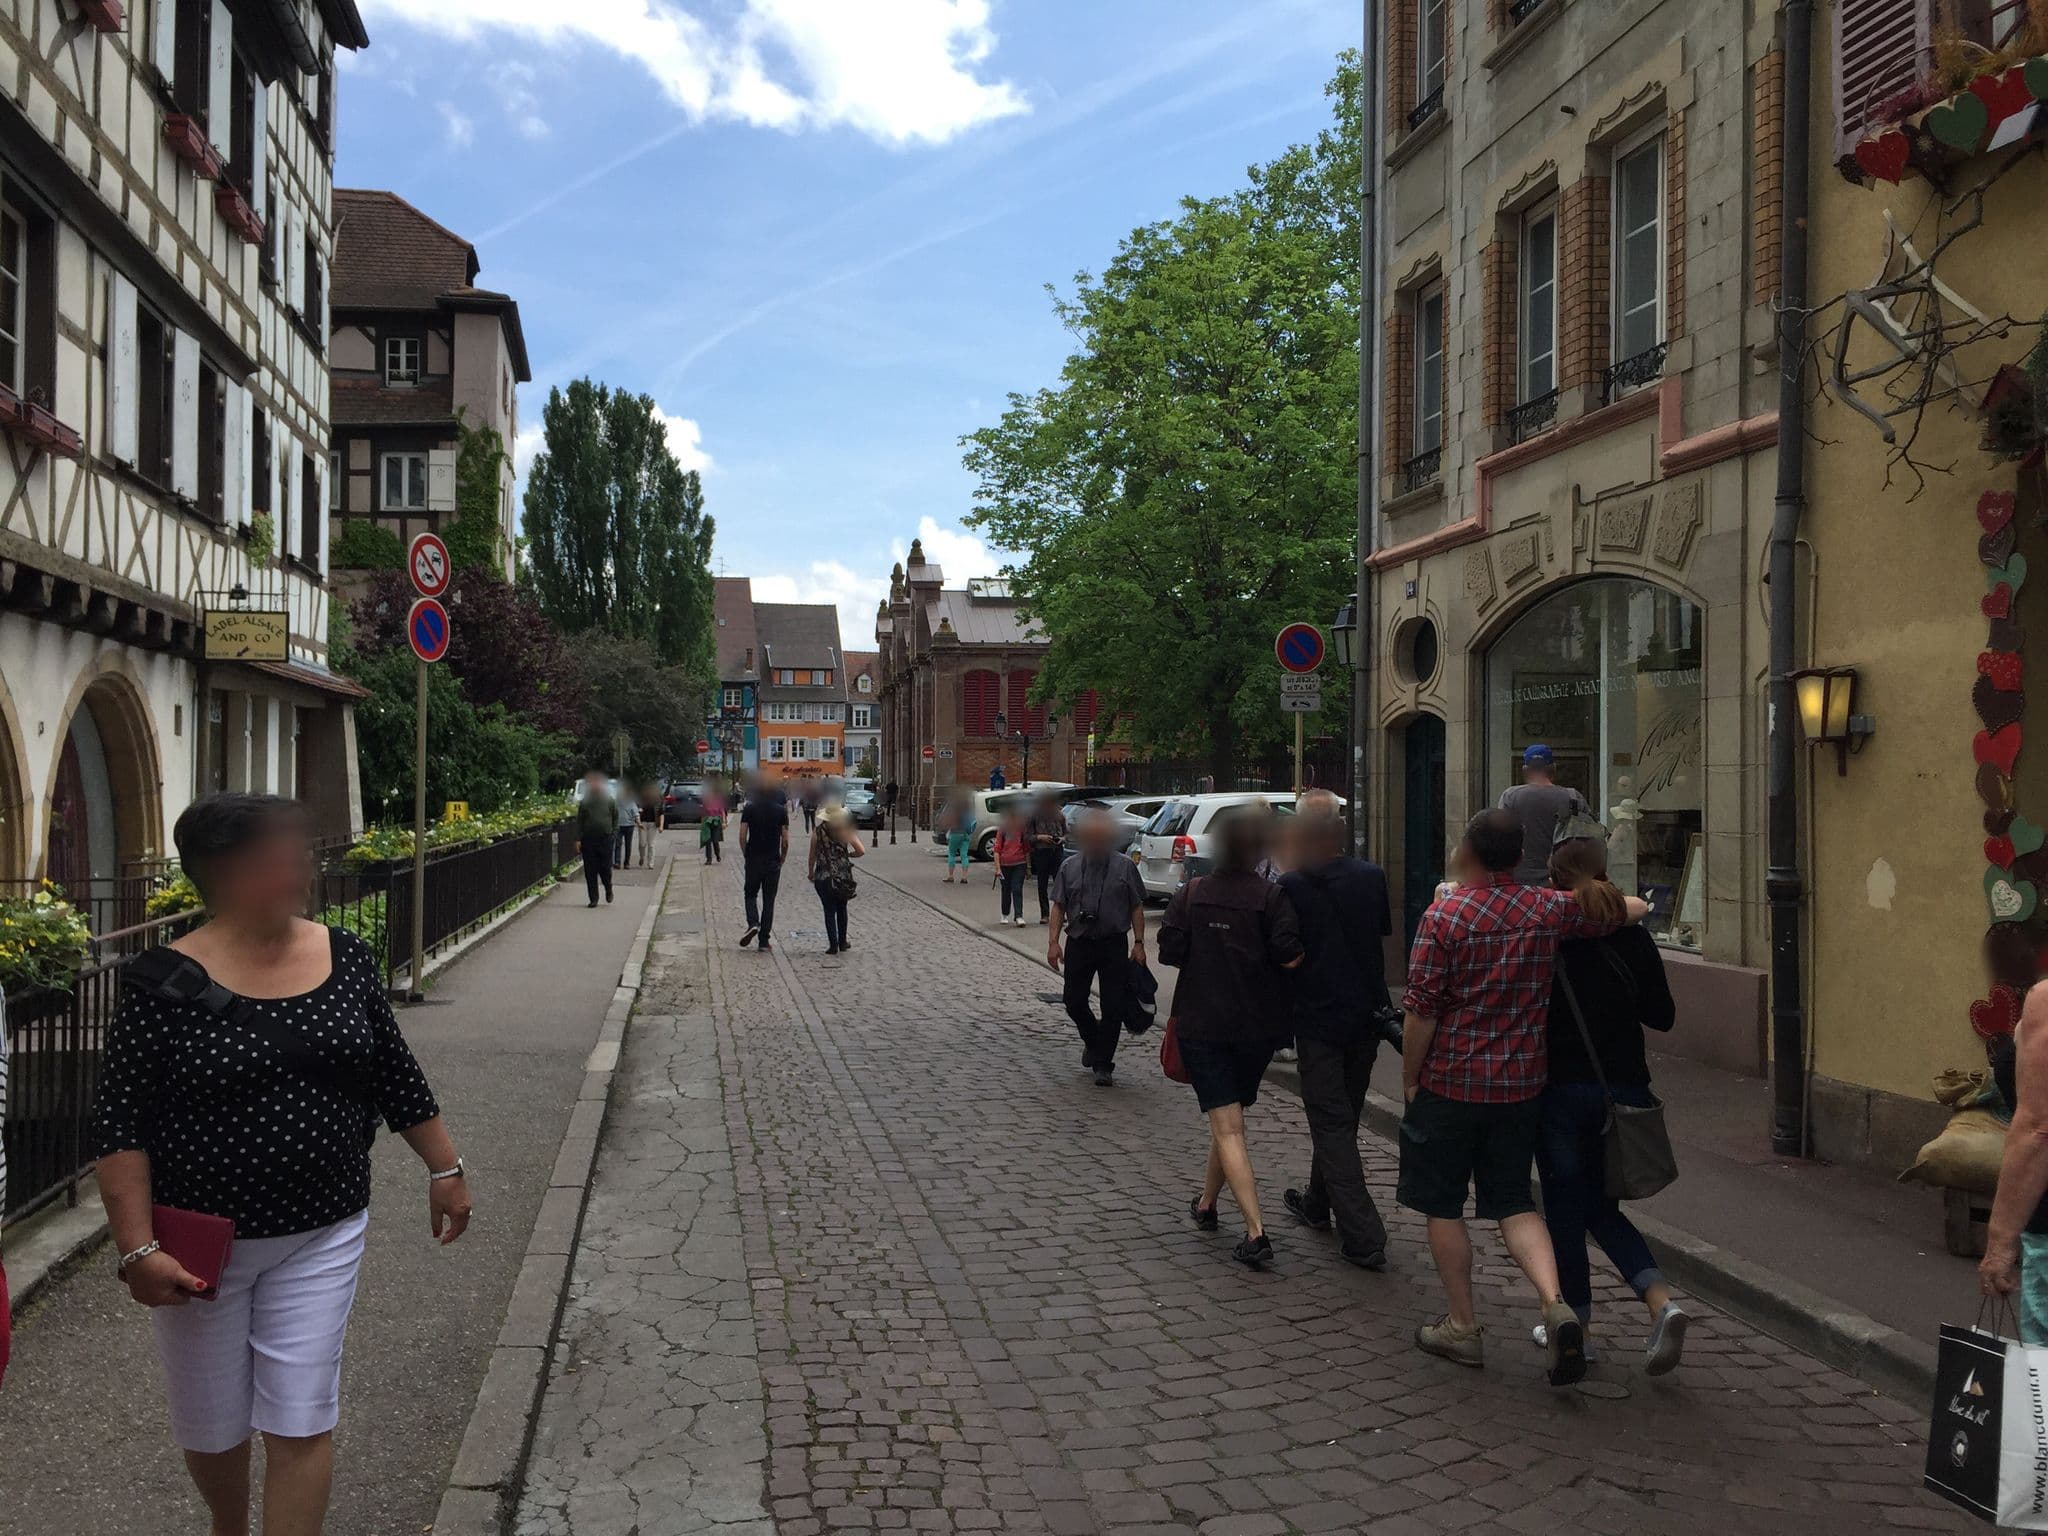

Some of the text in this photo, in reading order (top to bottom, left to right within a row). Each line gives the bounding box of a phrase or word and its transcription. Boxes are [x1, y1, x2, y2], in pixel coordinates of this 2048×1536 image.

[206, 616, 284, 638] LABEL ALSACE
[219, 633, 271, 643] AND CO
